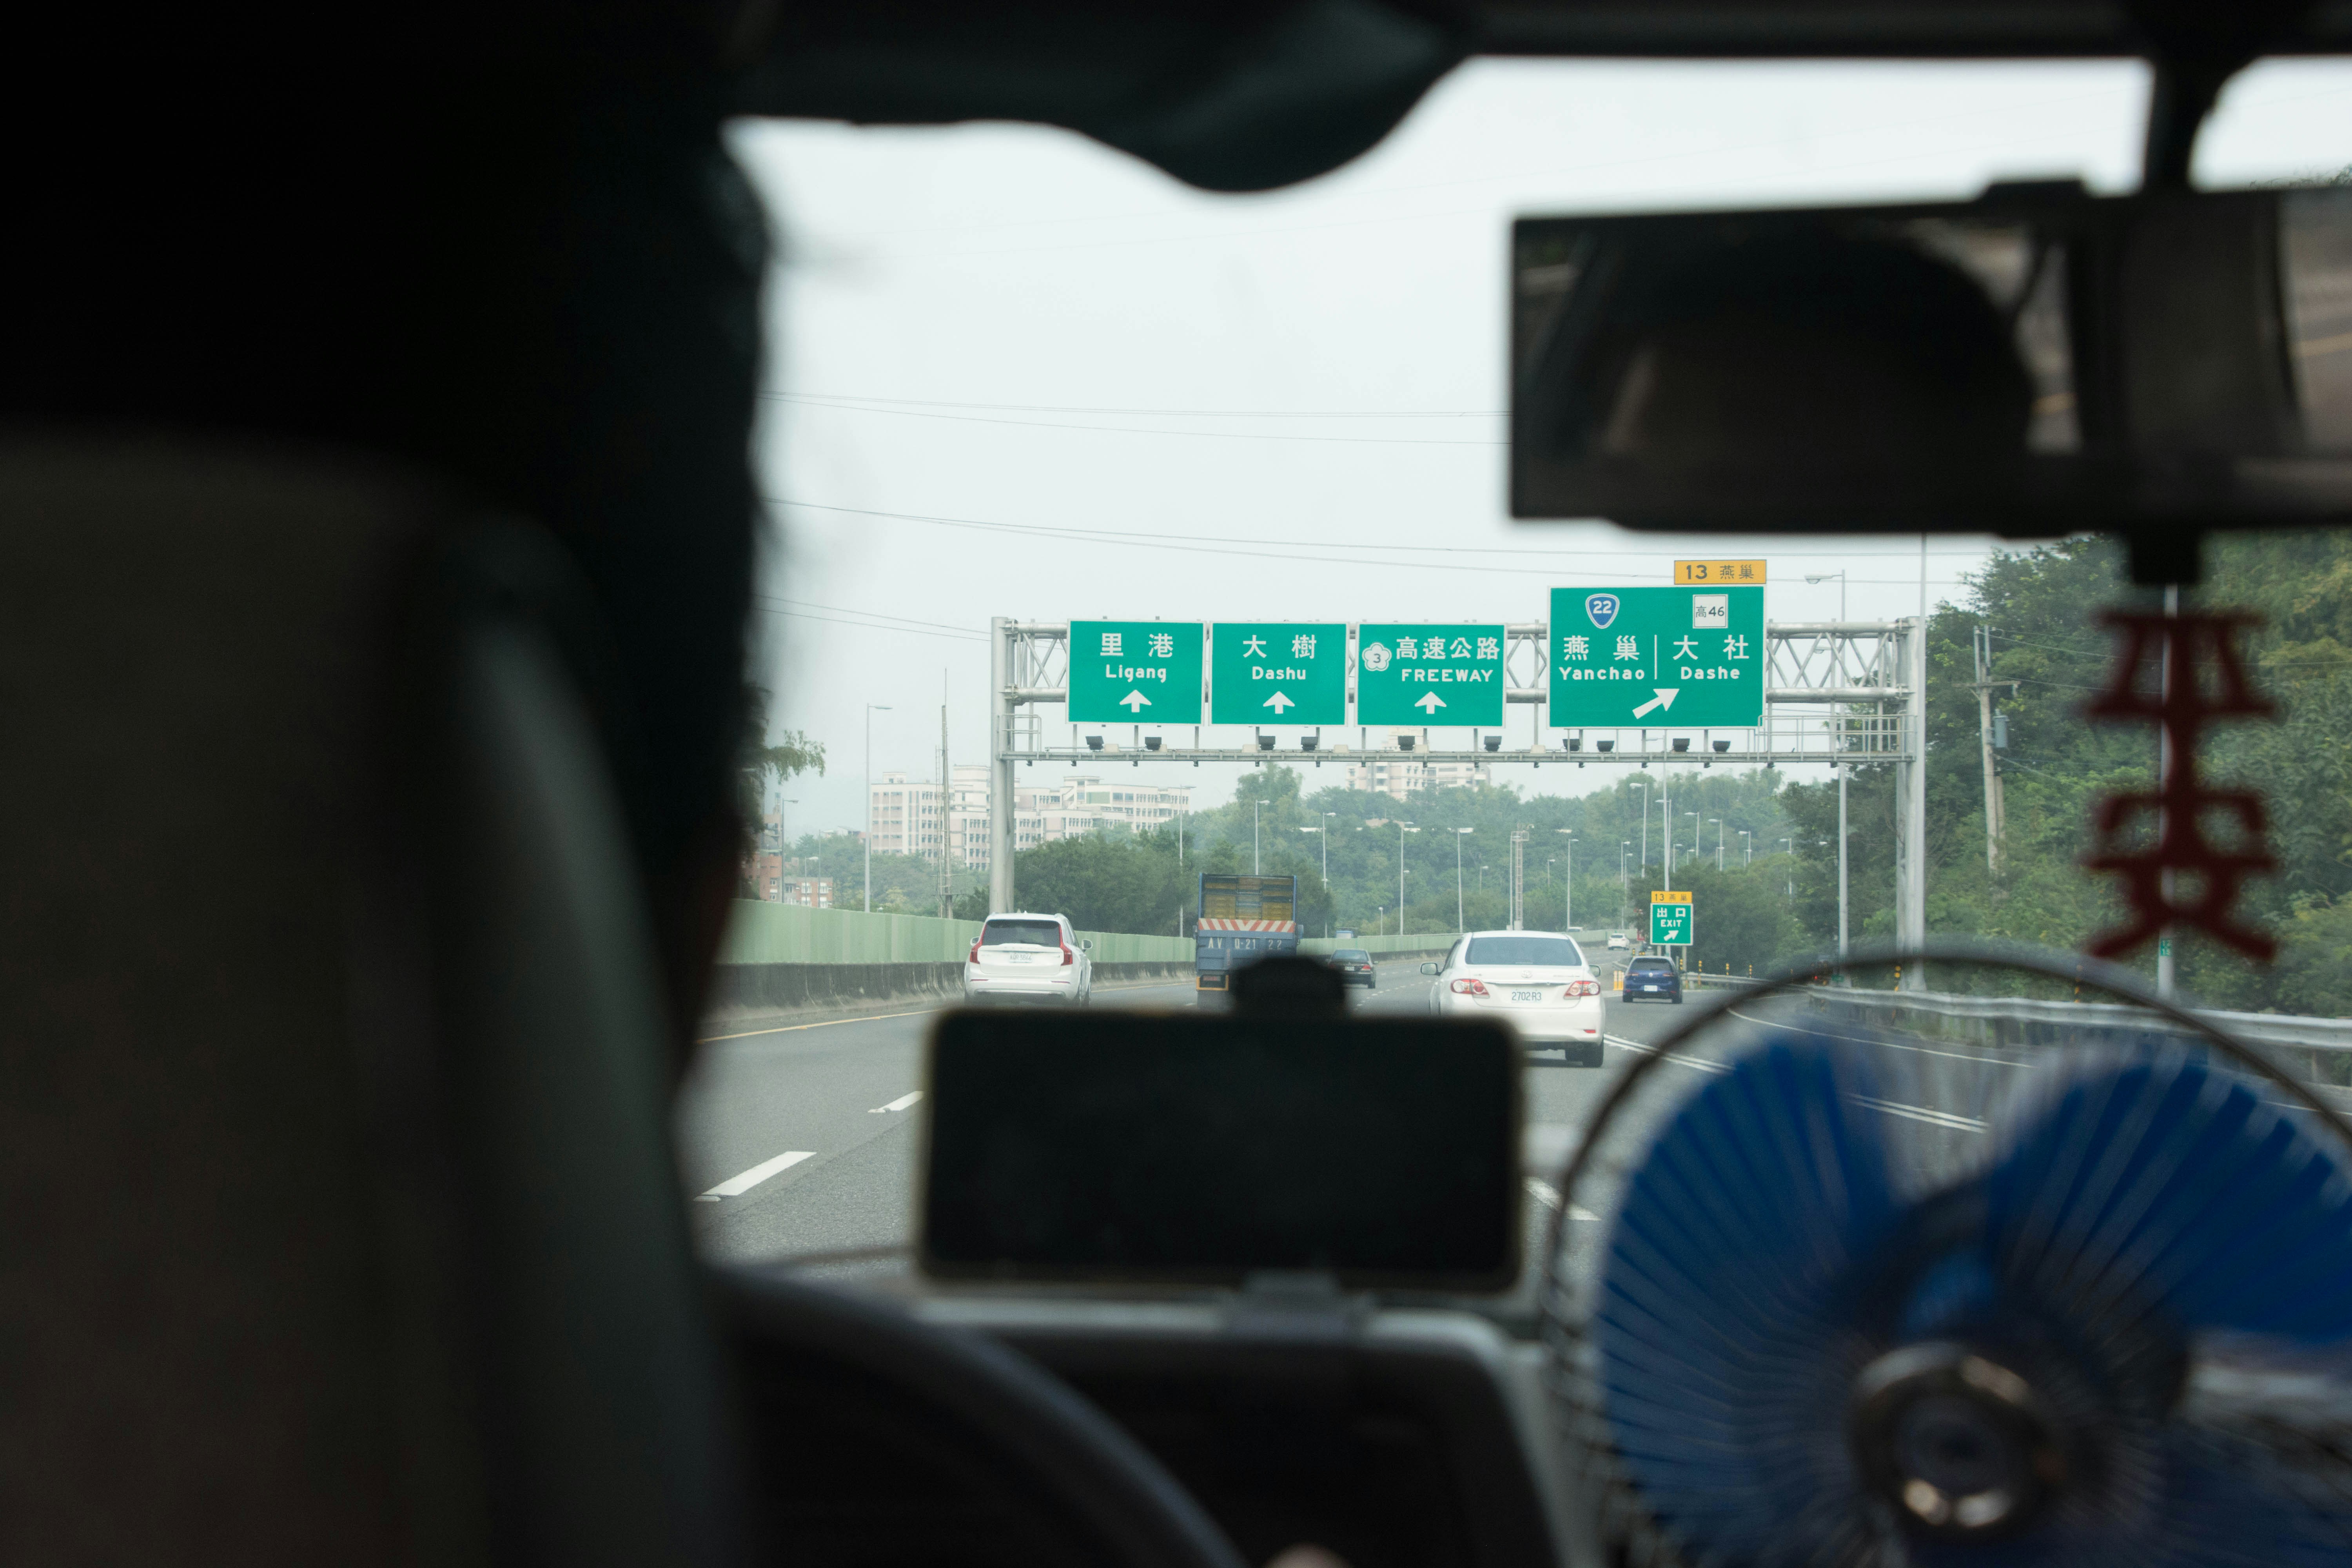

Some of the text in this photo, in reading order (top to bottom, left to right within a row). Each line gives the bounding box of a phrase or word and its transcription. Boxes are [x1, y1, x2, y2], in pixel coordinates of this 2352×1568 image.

[1687, 564, 1754, 579] 13 燕巢
[1593, 601, 1612, 613] 22
[1100, 633, 1173, 657] 里港
[1243, 635, 1316, 659] 大樹
[1397, 636, 1500, 659] 高速公路
[1564, 635, 1639, 661] 燕巢
[1673, 635, 1749, 660] 大社
[1374, 653, 1381, 663] 3
[1106, 664, 1166, 683] Ligang
[1252, 666, 1305, 679] Dashu
[1402, 669, 1493, 682] FREEWAY
[1559, 667, 1644, 680] Yanchao
[1681, 666, 1740, 679] Dashe
[1657, 907, 1686, 917] 出口
